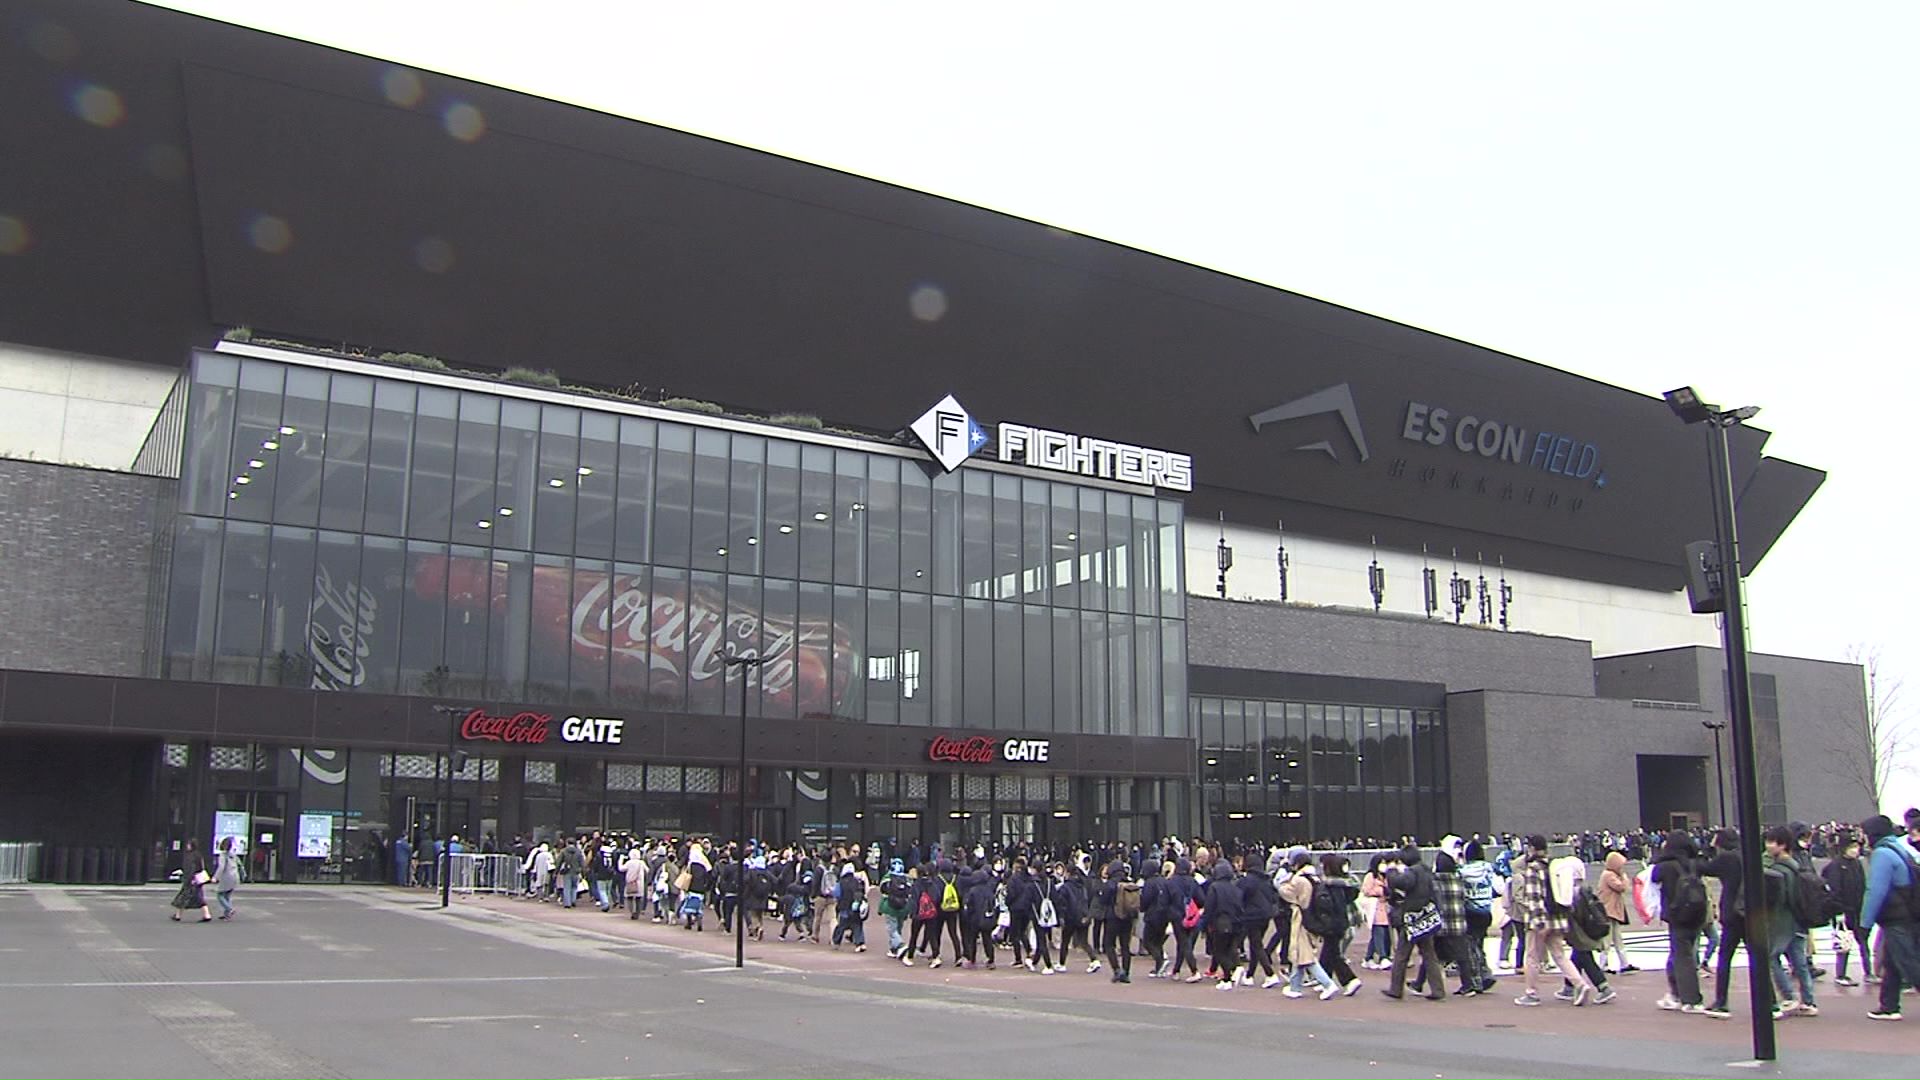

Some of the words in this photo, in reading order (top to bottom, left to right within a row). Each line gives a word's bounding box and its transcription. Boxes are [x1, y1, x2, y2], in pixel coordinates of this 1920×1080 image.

[999, 422, 1193, 492] FIGHTERS
[1403, 401, 1449, 446] ES
[1455, 416, 1526, 464] CON
[1530, 432, 1597, 479] FIELD
[461, 709, 552, 744] Coca-Cola
[561, 716, 624, 744] GATE
[1003, 739, 1050, 762] GATE
